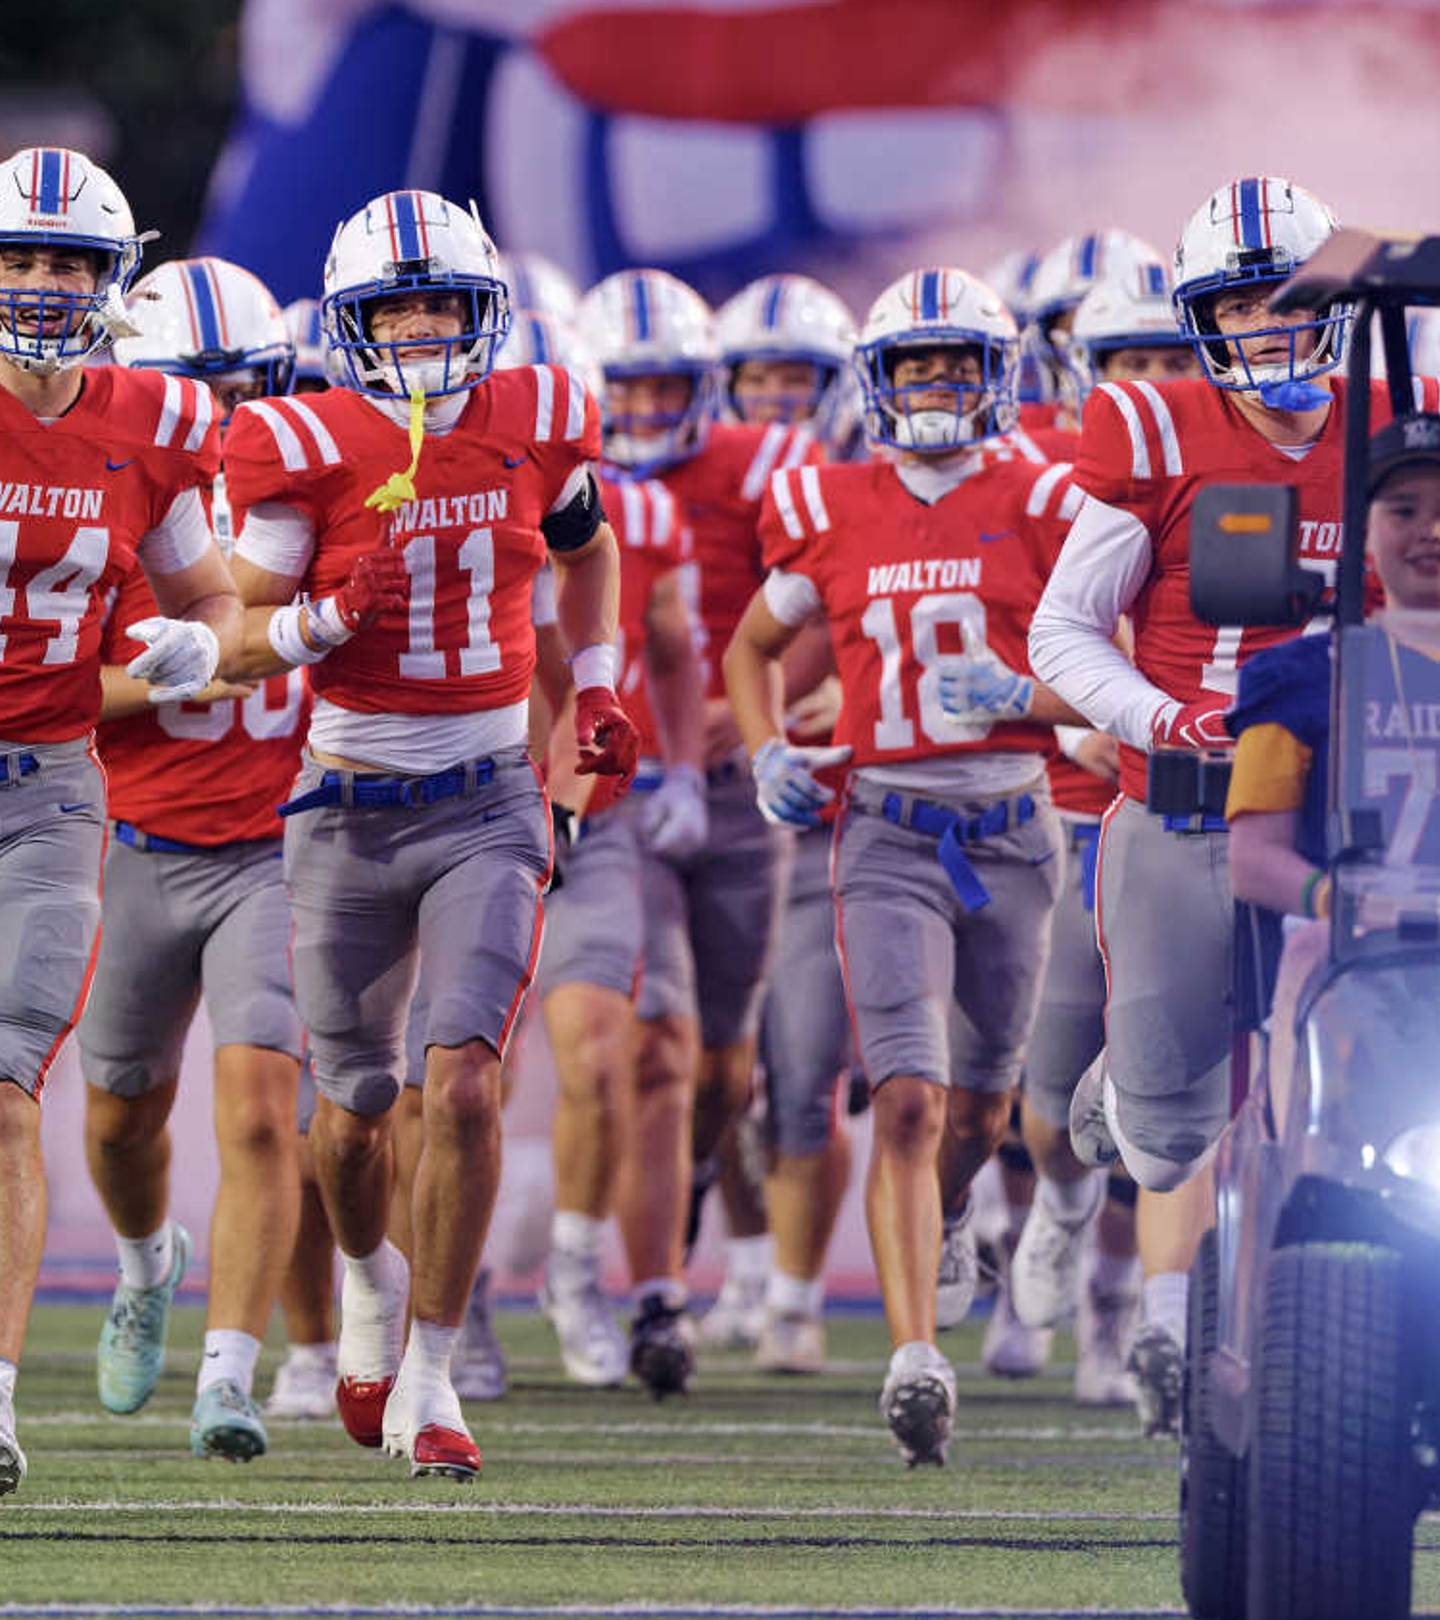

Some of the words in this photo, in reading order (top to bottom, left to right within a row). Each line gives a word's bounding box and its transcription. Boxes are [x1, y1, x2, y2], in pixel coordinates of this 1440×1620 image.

[390, 488, 508, 535] WALTON
[398, 527, 502, 680] 11
[866, 557, 981, 596] WALTON
[861, 592, 987, 750] 18
